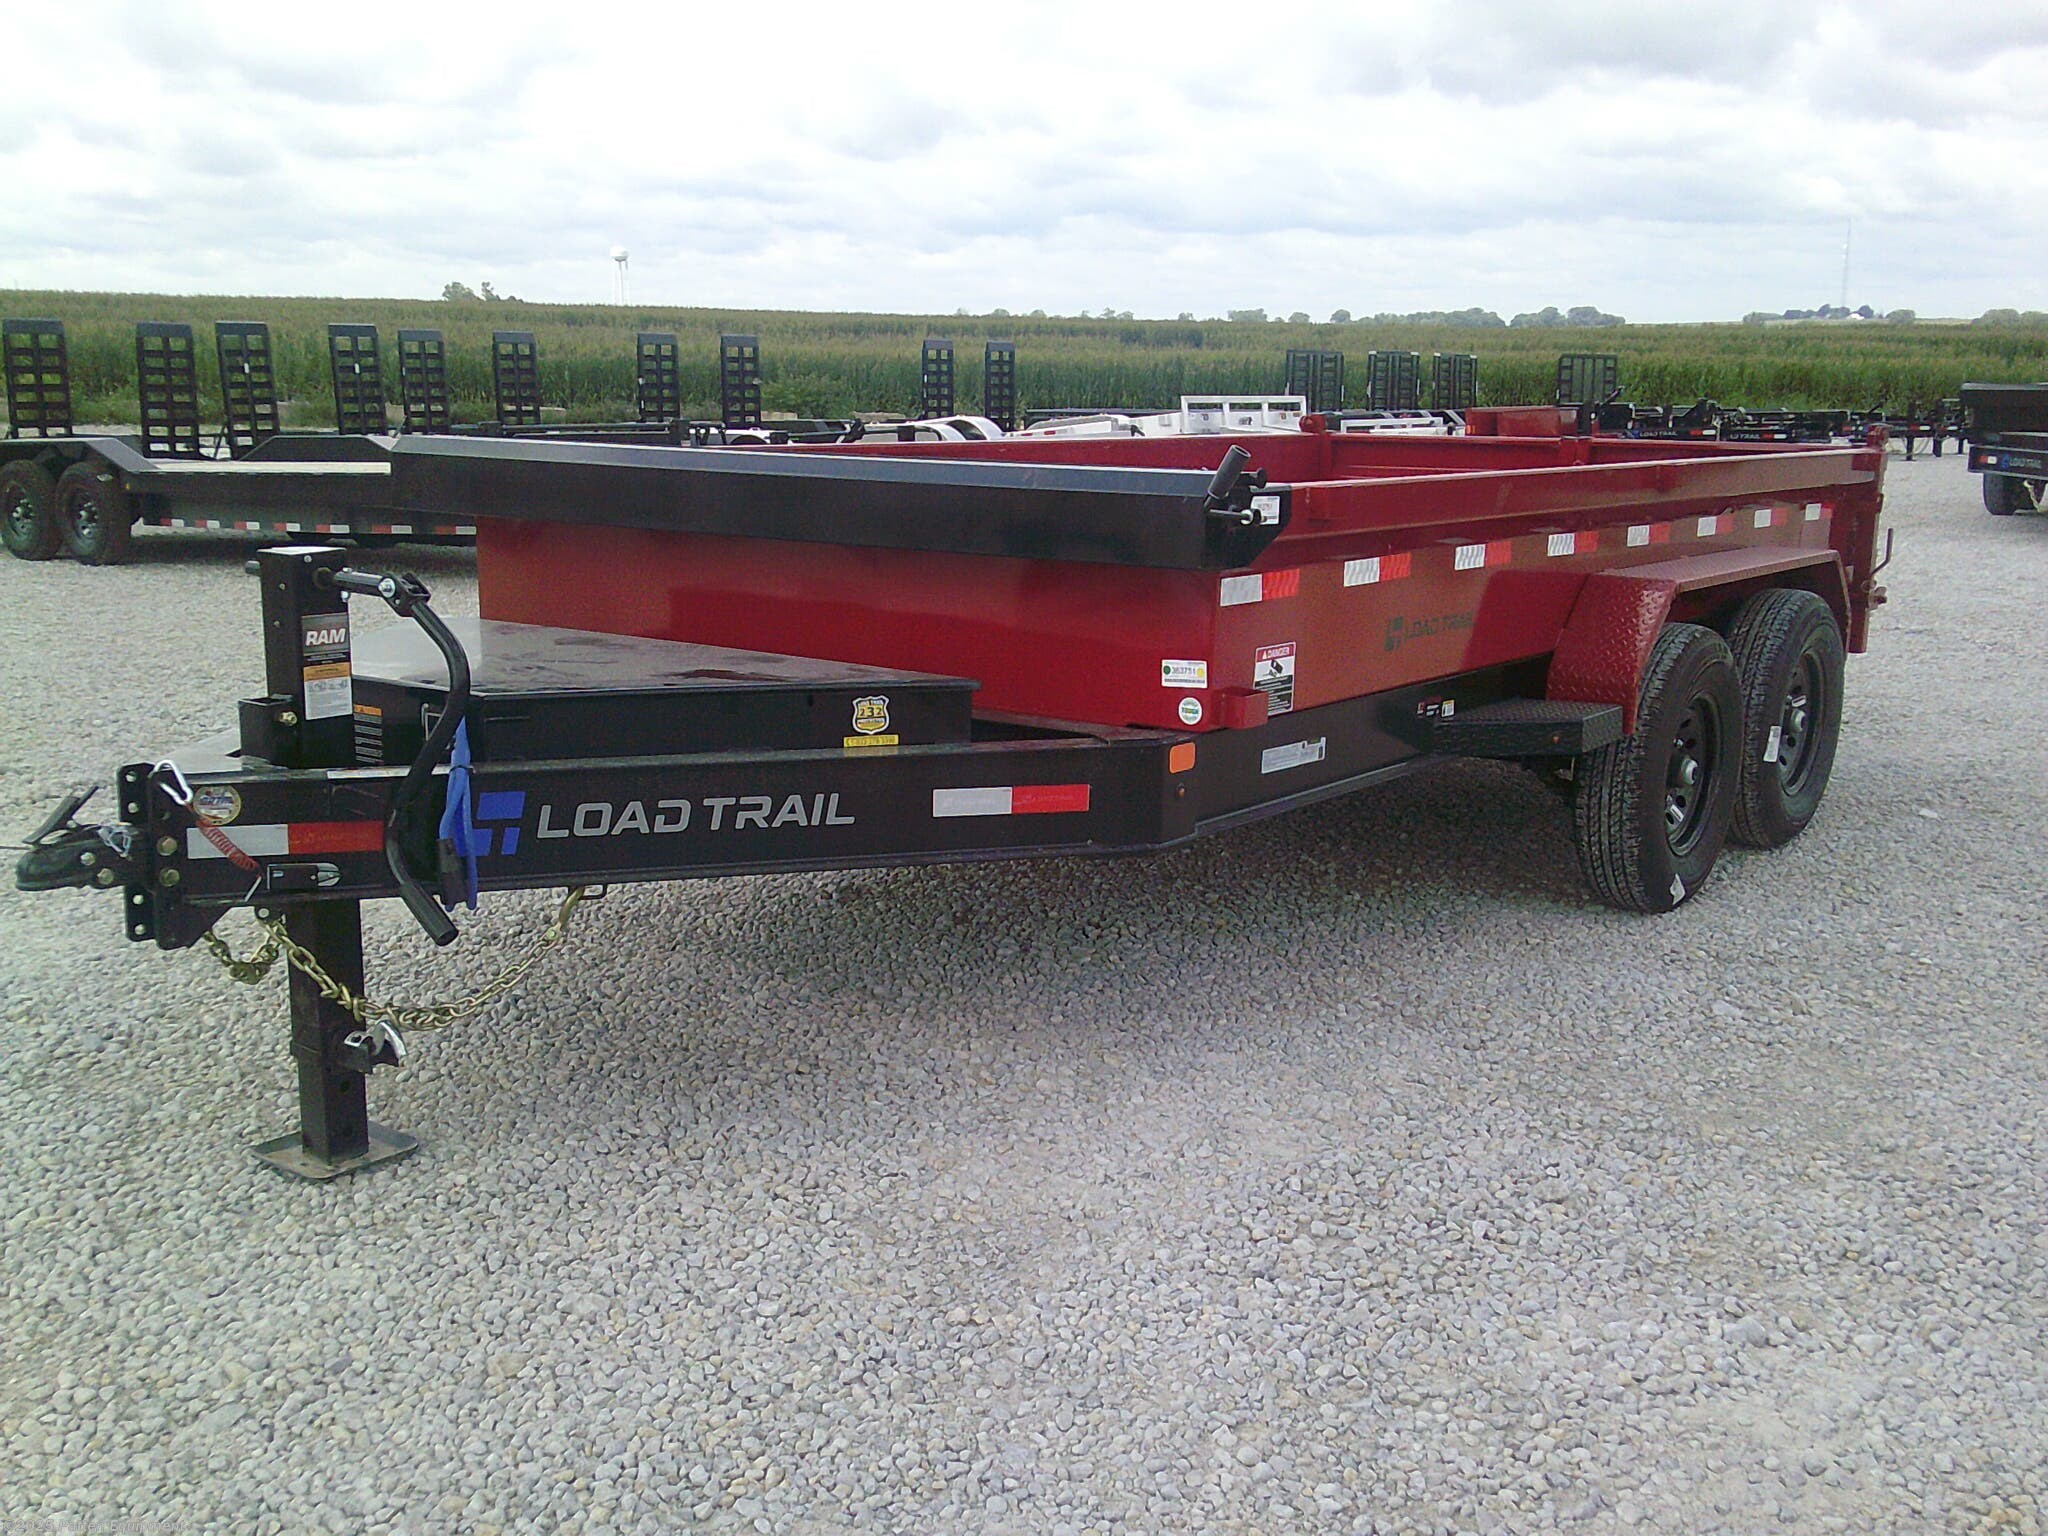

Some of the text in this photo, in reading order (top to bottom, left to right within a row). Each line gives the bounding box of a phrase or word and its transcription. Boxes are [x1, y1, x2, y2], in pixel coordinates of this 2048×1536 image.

[305, 628, 346, 646] RAM
[536, 792, 856, 839] LOAD TRAIL
